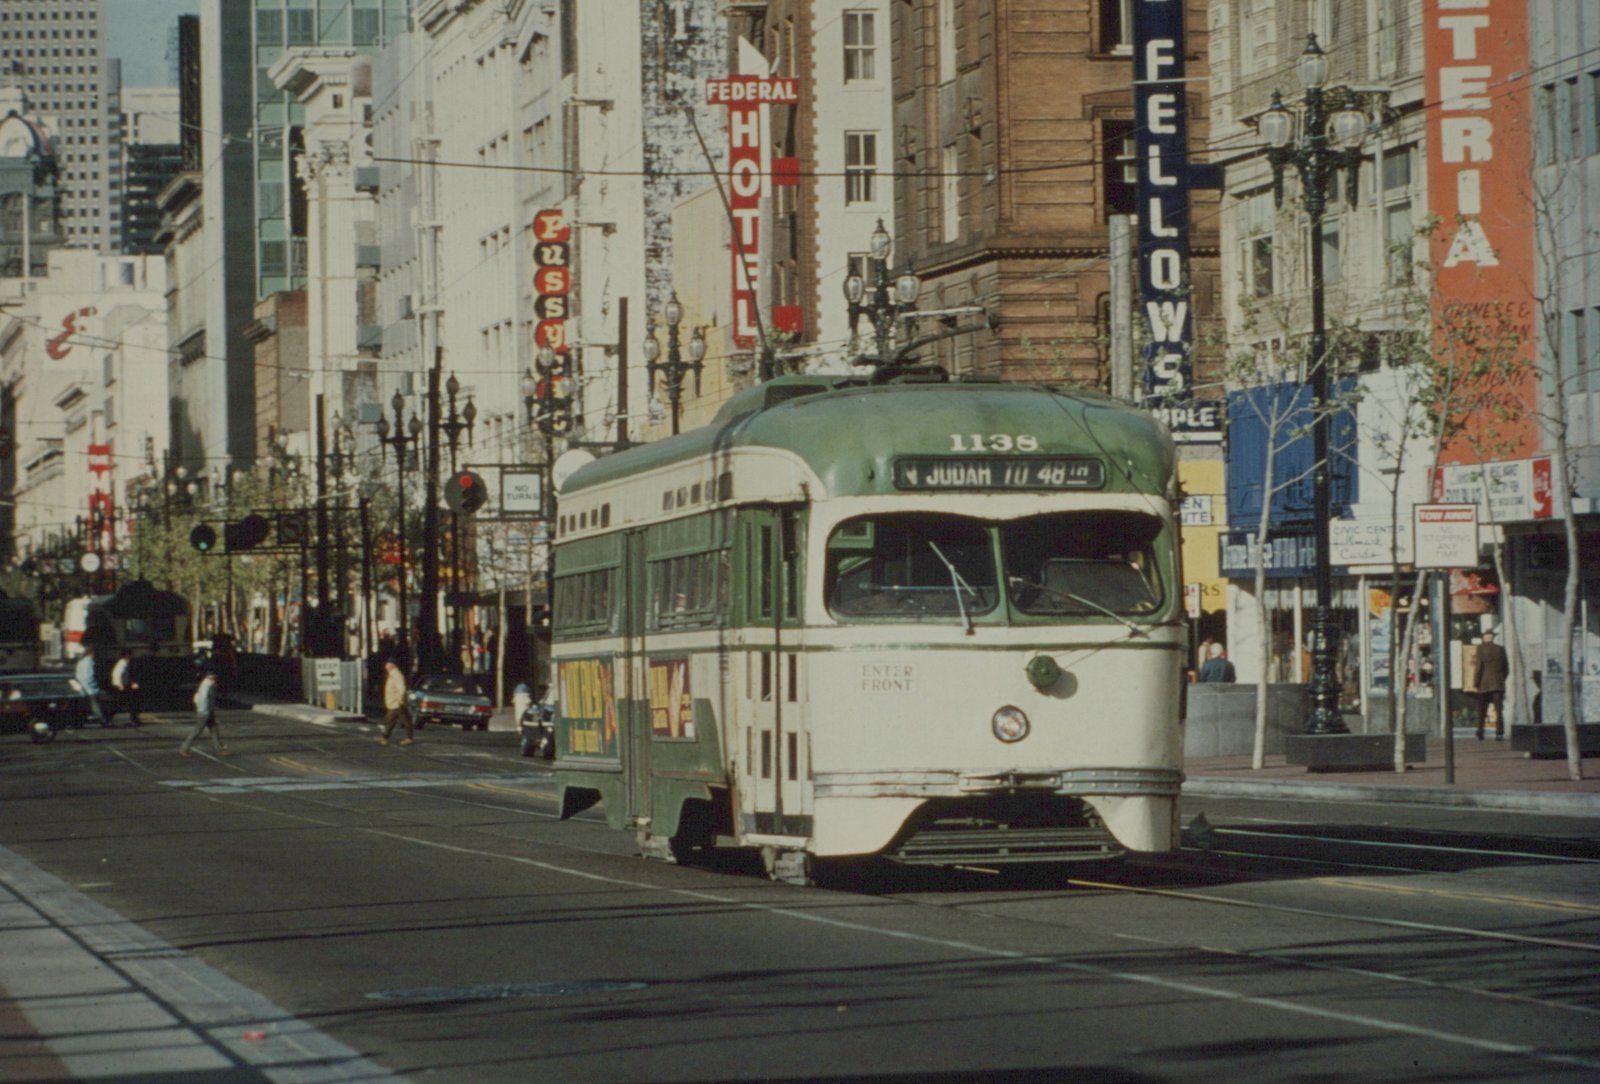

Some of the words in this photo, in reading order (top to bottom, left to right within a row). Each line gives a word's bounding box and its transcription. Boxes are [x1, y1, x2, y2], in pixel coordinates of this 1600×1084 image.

[707, 81, 797, 101] FEDERAL
[1438, 0, 1499, 267] TERIA
[732, 111, 760, 336] HOTEL
[1146, 39, 1187, 394] FELLOWS
[950, 434, 1039, 451] 1138
[926, 467, 991, 486] JUDAH
[506, 492, 540, 500] TURNS
[1420, 511, 1444, 520] TOW
[1446, 510, 1473, 520] AWAY
[1367, 526, 1405, 534] CENTR
[863, 664, 912, 676] ENTER
[863, 680, 912, 691] FRONT
